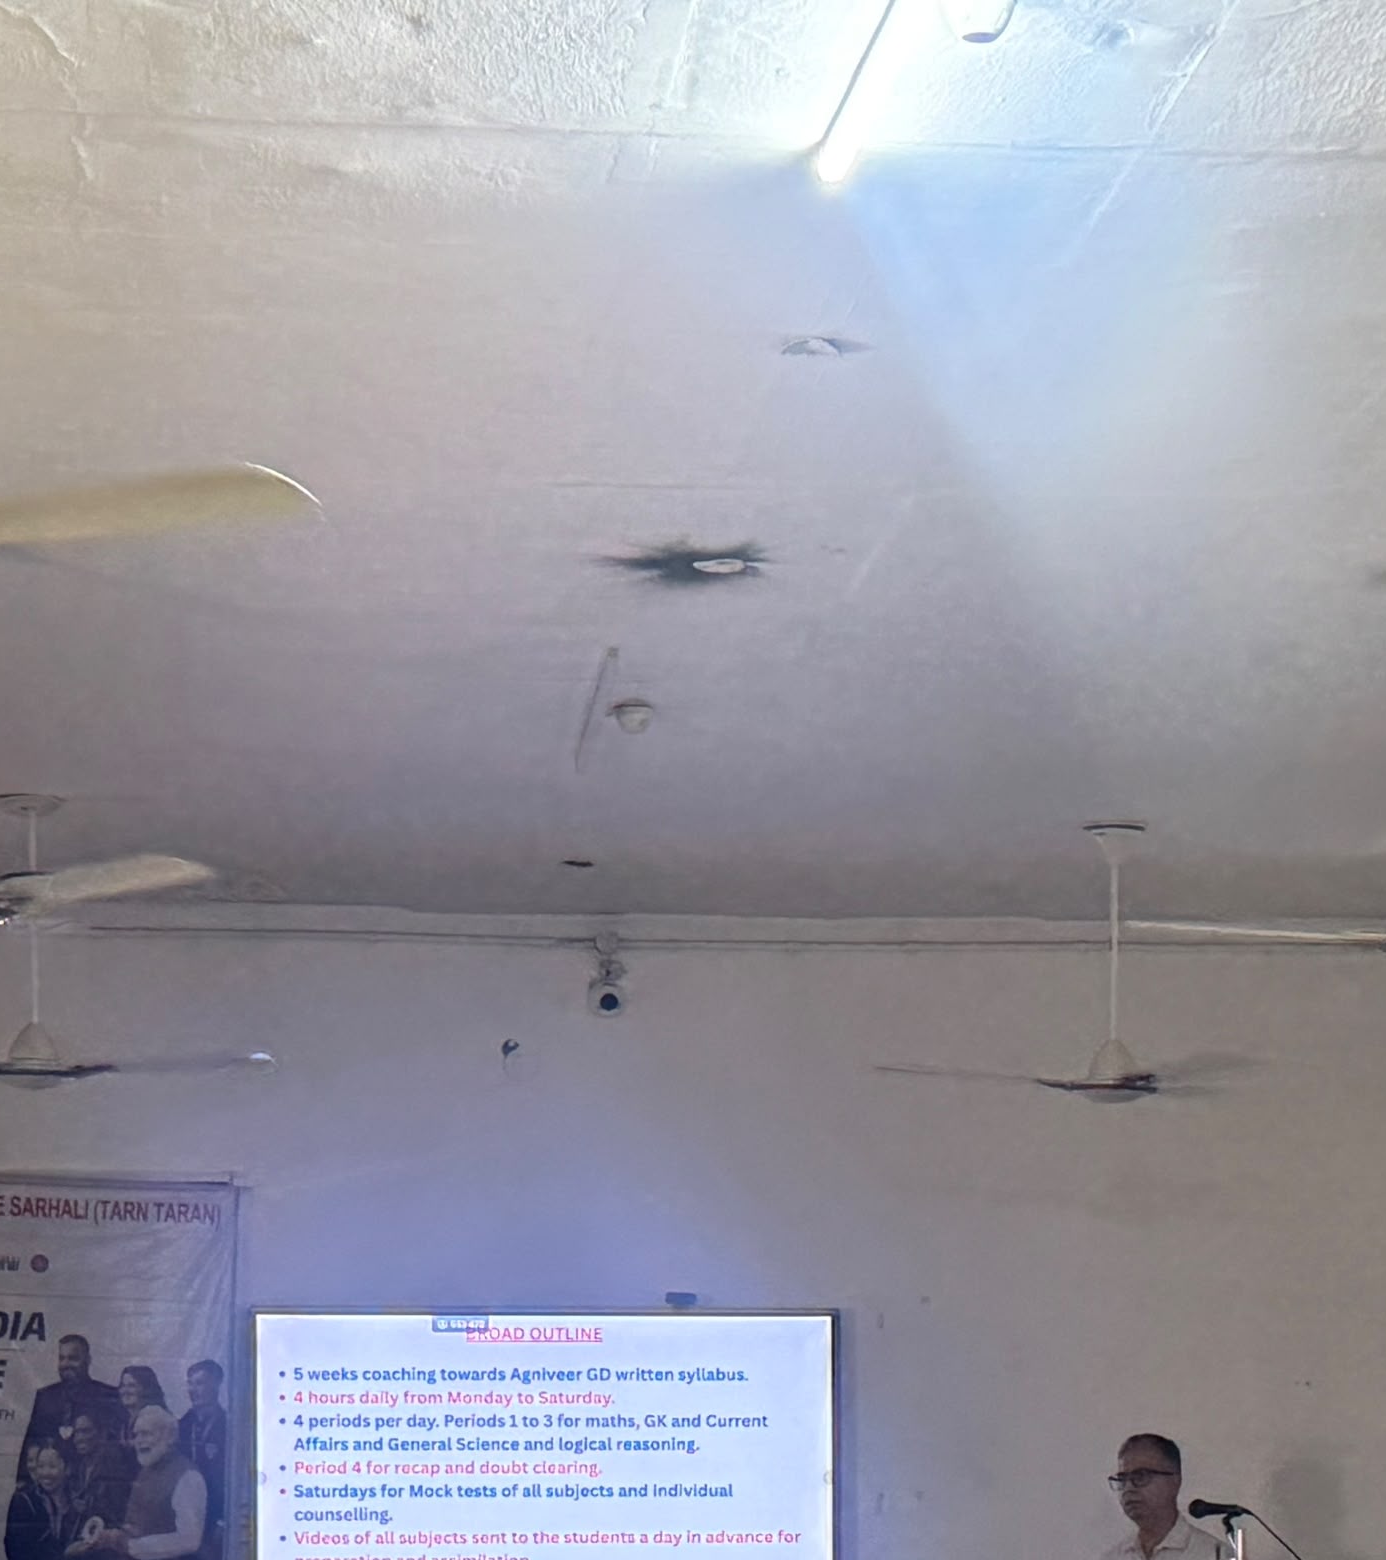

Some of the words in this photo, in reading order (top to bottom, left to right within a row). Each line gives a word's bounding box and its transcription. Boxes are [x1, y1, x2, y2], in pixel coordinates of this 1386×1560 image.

[9, 1195, 89, 1220] SARHALI
[93, 1199, 148, 1225] (TARN
[153, 1202, 221, 1231] TARAN)
[530, 1326, 603, 1342] OUTLINE
[293, 1366, 304, 1382] 5
[306, 1366, 359, 1382] weeks
[361, 1366, 438, 1385] coaching
[439, 1366, 507, 1382] towards
[509, 1366, 584, 1386] Agniveer
[586, 1367, 612, 1382] GD
[614, 1366, 675, 1382] written
[677, 1367, 749, 1386] syllabus.
[293, 1390, 304, 1404] 4
[308, 1390, 356, 1405] hours
[359, 1389, 399, 1409] daily
[403, 1389, 443, 1405] from
[447, 1390, 514, 1409] Monday
[516, 1392, 535, 1405] to
[538, 1390, 616, 1409] Saturday.
[293, 1413, 305, 1428] 4
[308, 1412, 372, 1433] periods
[374, 1416, 403, 1432] per
[405, 1413, 440, 1432] day.
[443, 1413, 507, 1429] Periods
[508, 1413, 519, 1429] 1
[521, 1415, 540, 1429] to
[542, 1413, 554, 1429] 3
[556, 1412, 582, 1429] for
[585, 1413, 641, 1431] maths,
[643, 1413, 668, 1429] GK
[670, 1413, 702, 1429] and
[705, 1413, 769, 1429] Current
[293, 1436, 350, 1452] Affairs
[352, 1436, 384, 1452] and
[387, 1436, 453, 1452] General
[455, 1436, 521, 1452] Science
[523, 1436, 555, 1452] and
[558, 1436, 613, 1455] logical
[616, 1436, 701, 1455] reasoning.
[294, 1460, 348, 1475] Period
[351, 1460, 362, 1475] 4
[365, 1459, 391, 1475] for
[394, 1463, 441, 1478] recap
[444, 1460, 476, 1475] and
[479, 1459, 529, 1475] doubt
[532, 1460, 603, 1478] clearing.
[293, 1483, 378, 1502] Saturdays
[379, 1483, 406, 1499] for
[408, 1483, 454, 1499] Mock
[456, 1484, 498, 1499] tests
[500, 1483, 519, 1498] of
[522, 1483, 543, 1499] all
[545, 1483, 615, 1502] subjects
[617, 1483, 649, 1498] and
[652, 1483, 734, 1498] individual
[293, 1506, 394, 1526] counselling.
[293, 1530, 351, 1546] Videos
[353, 1530, 372, 1545] of
[374, 1530, 396, 1545] all
[398, 1530, 468, 1549] subjects
[471, 1532, 508, 1545] sent
[511, 1532, 529, 1545] to
[532, 1530, 560, 1545] the
[563, 1530, 636, 1544] students
[639, 1533, 650, 1544] a
[652, 1530, 683, 1548] day
[686, 1529, 702, 1545] in
[705, 1529, 774, 1544] advance
[777, 1528, 802, 1544] for
